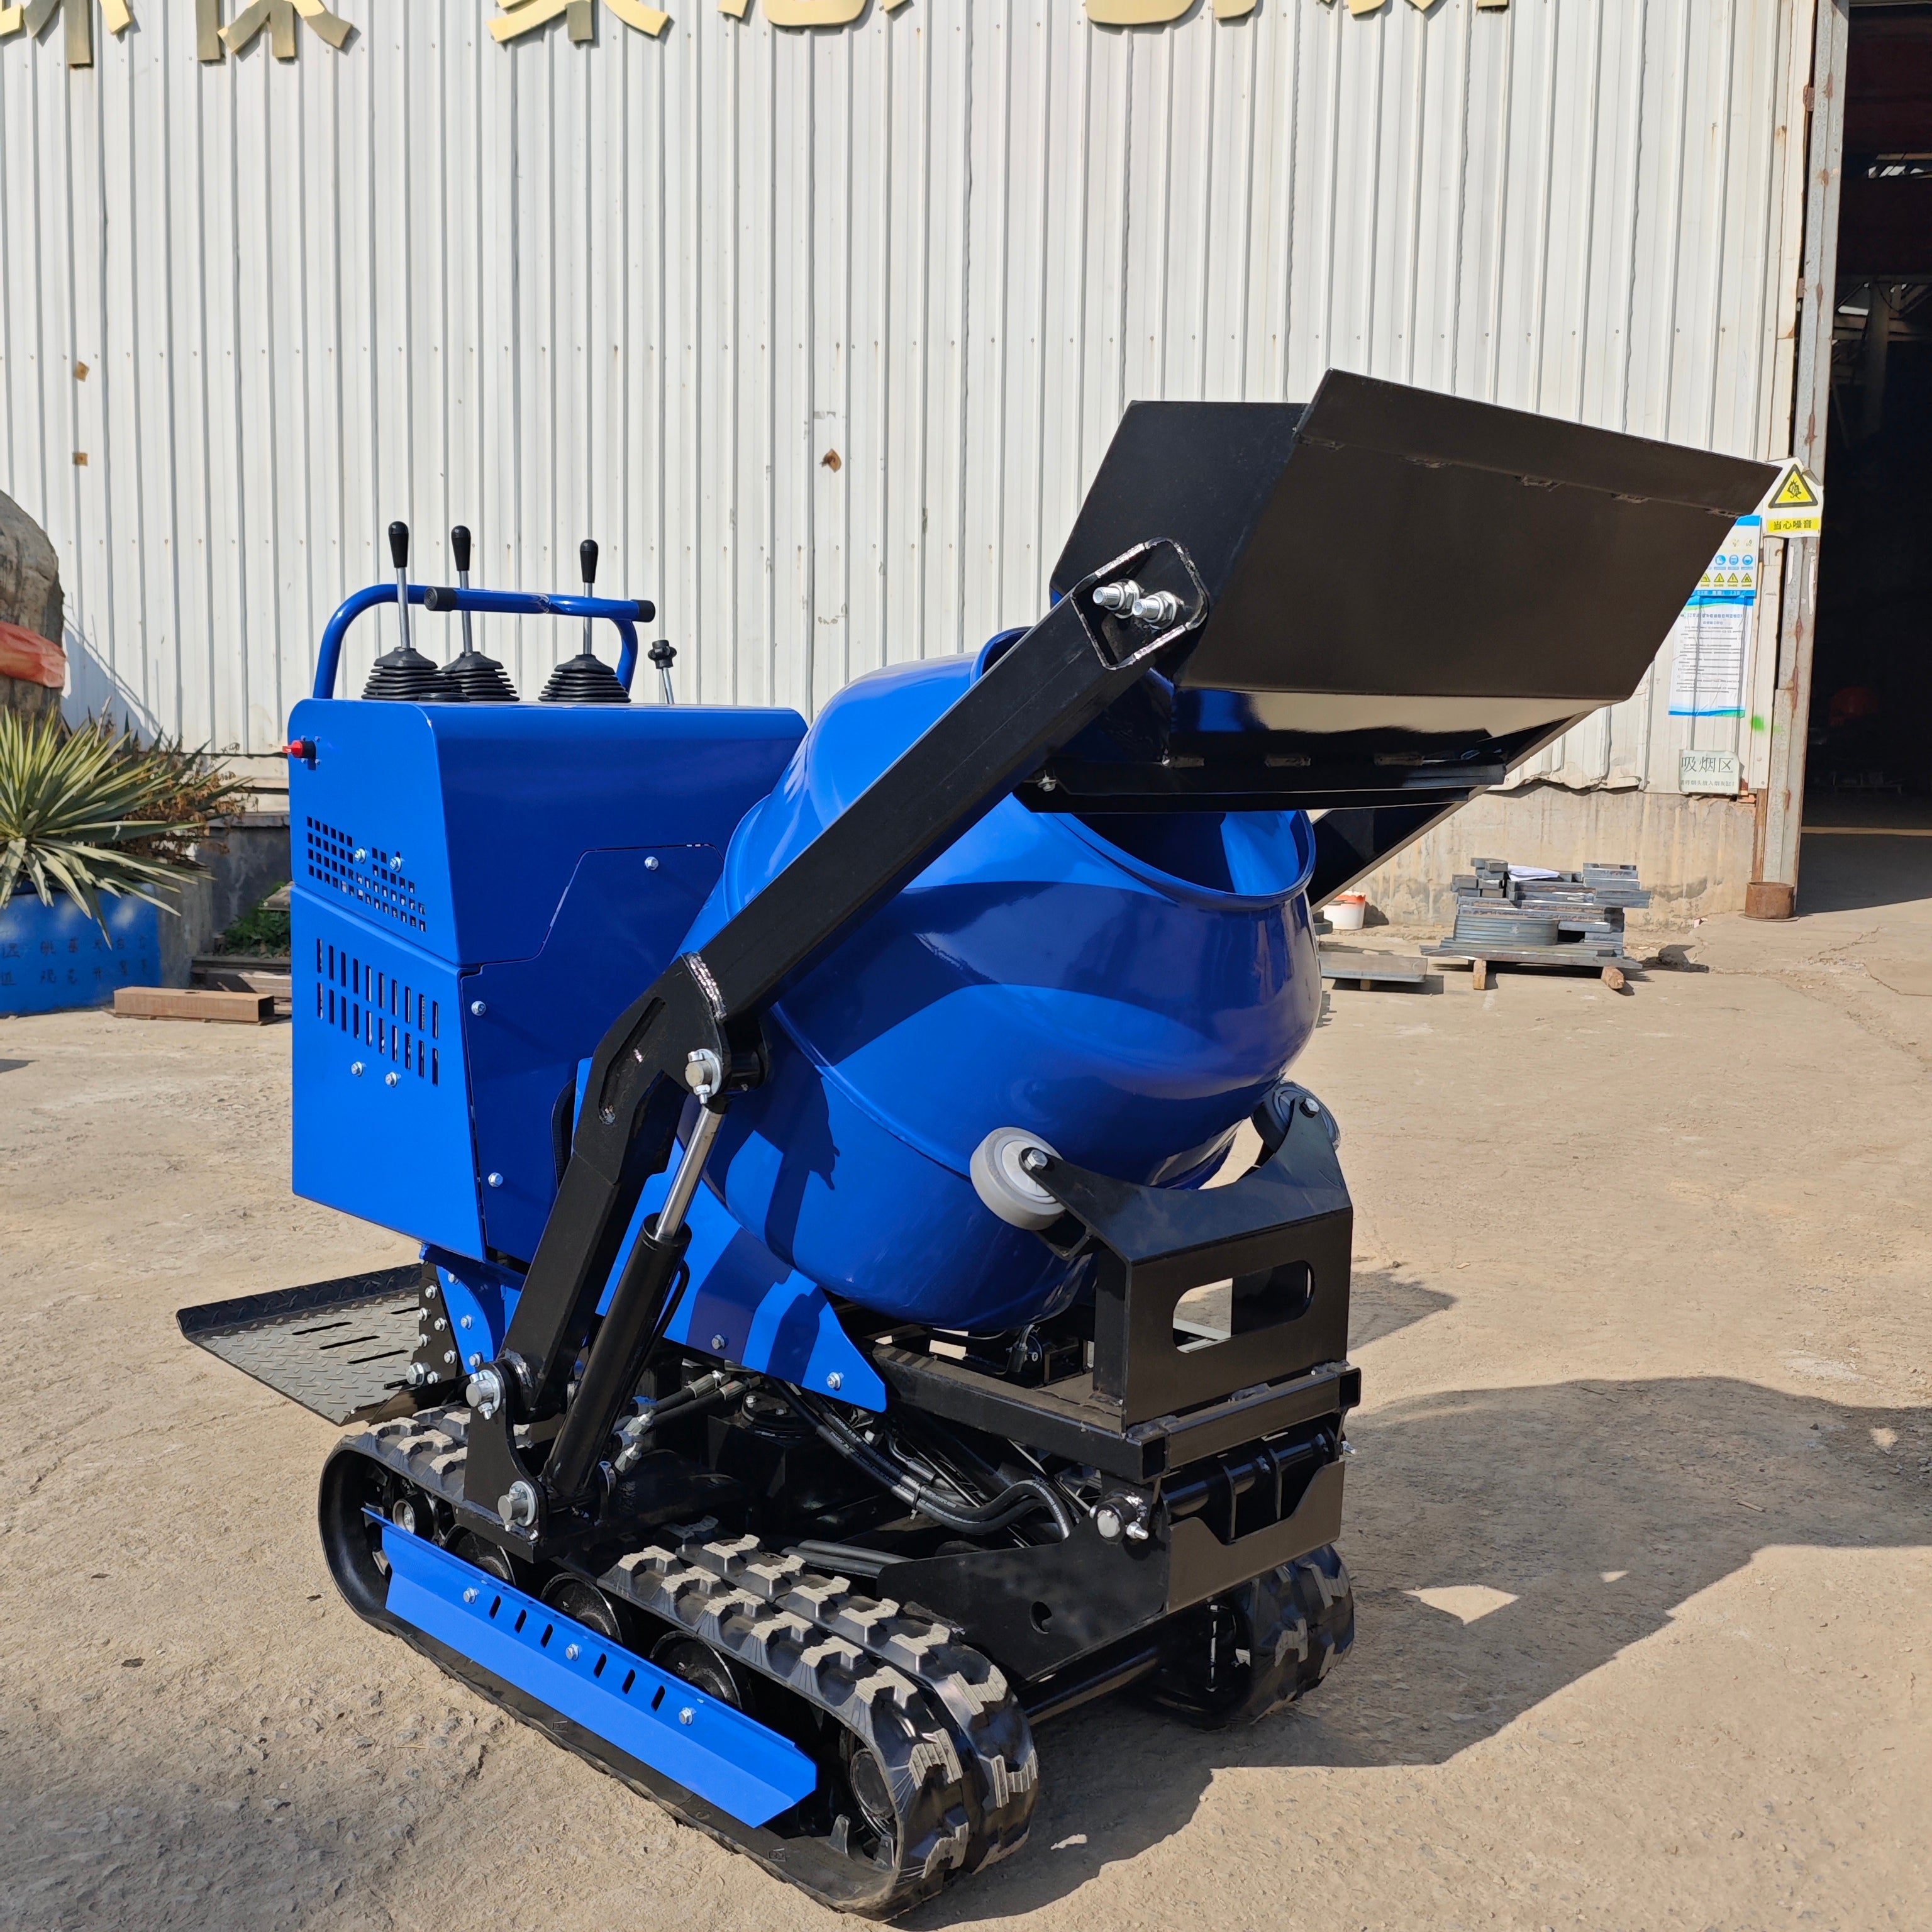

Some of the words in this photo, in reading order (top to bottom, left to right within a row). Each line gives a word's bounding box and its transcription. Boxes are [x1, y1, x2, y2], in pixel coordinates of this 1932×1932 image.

[1774, 519, 1812, 530] 当心噪音
[1681, 757, 1734, 773] 吸烟区
